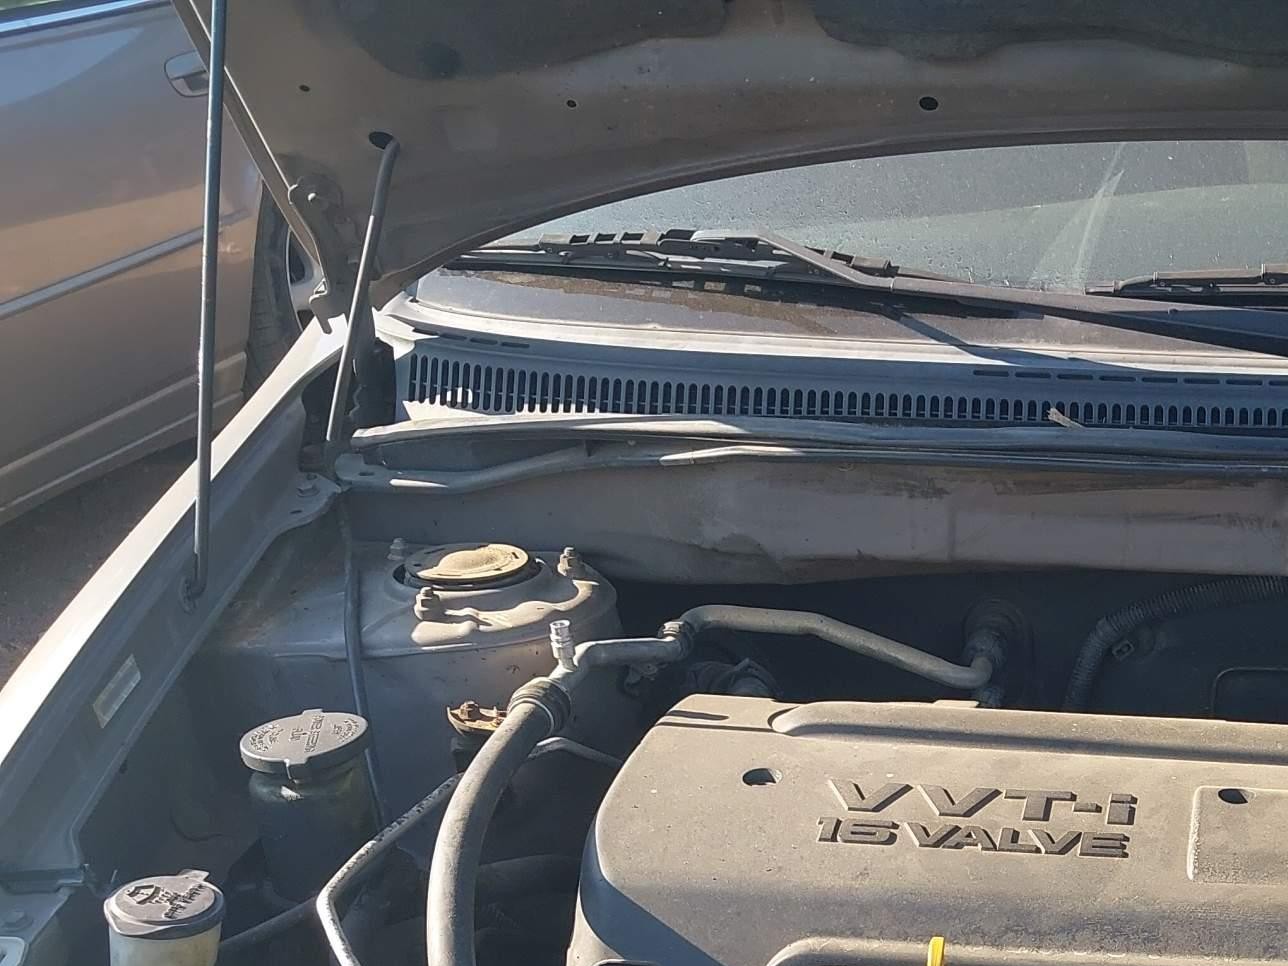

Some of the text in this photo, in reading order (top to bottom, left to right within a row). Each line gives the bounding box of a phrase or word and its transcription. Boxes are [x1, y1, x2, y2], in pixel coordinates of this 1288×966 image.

[828, 779, 1138, 826] VVT-i
[816, 816, 1131, 859] 16 VALVE
